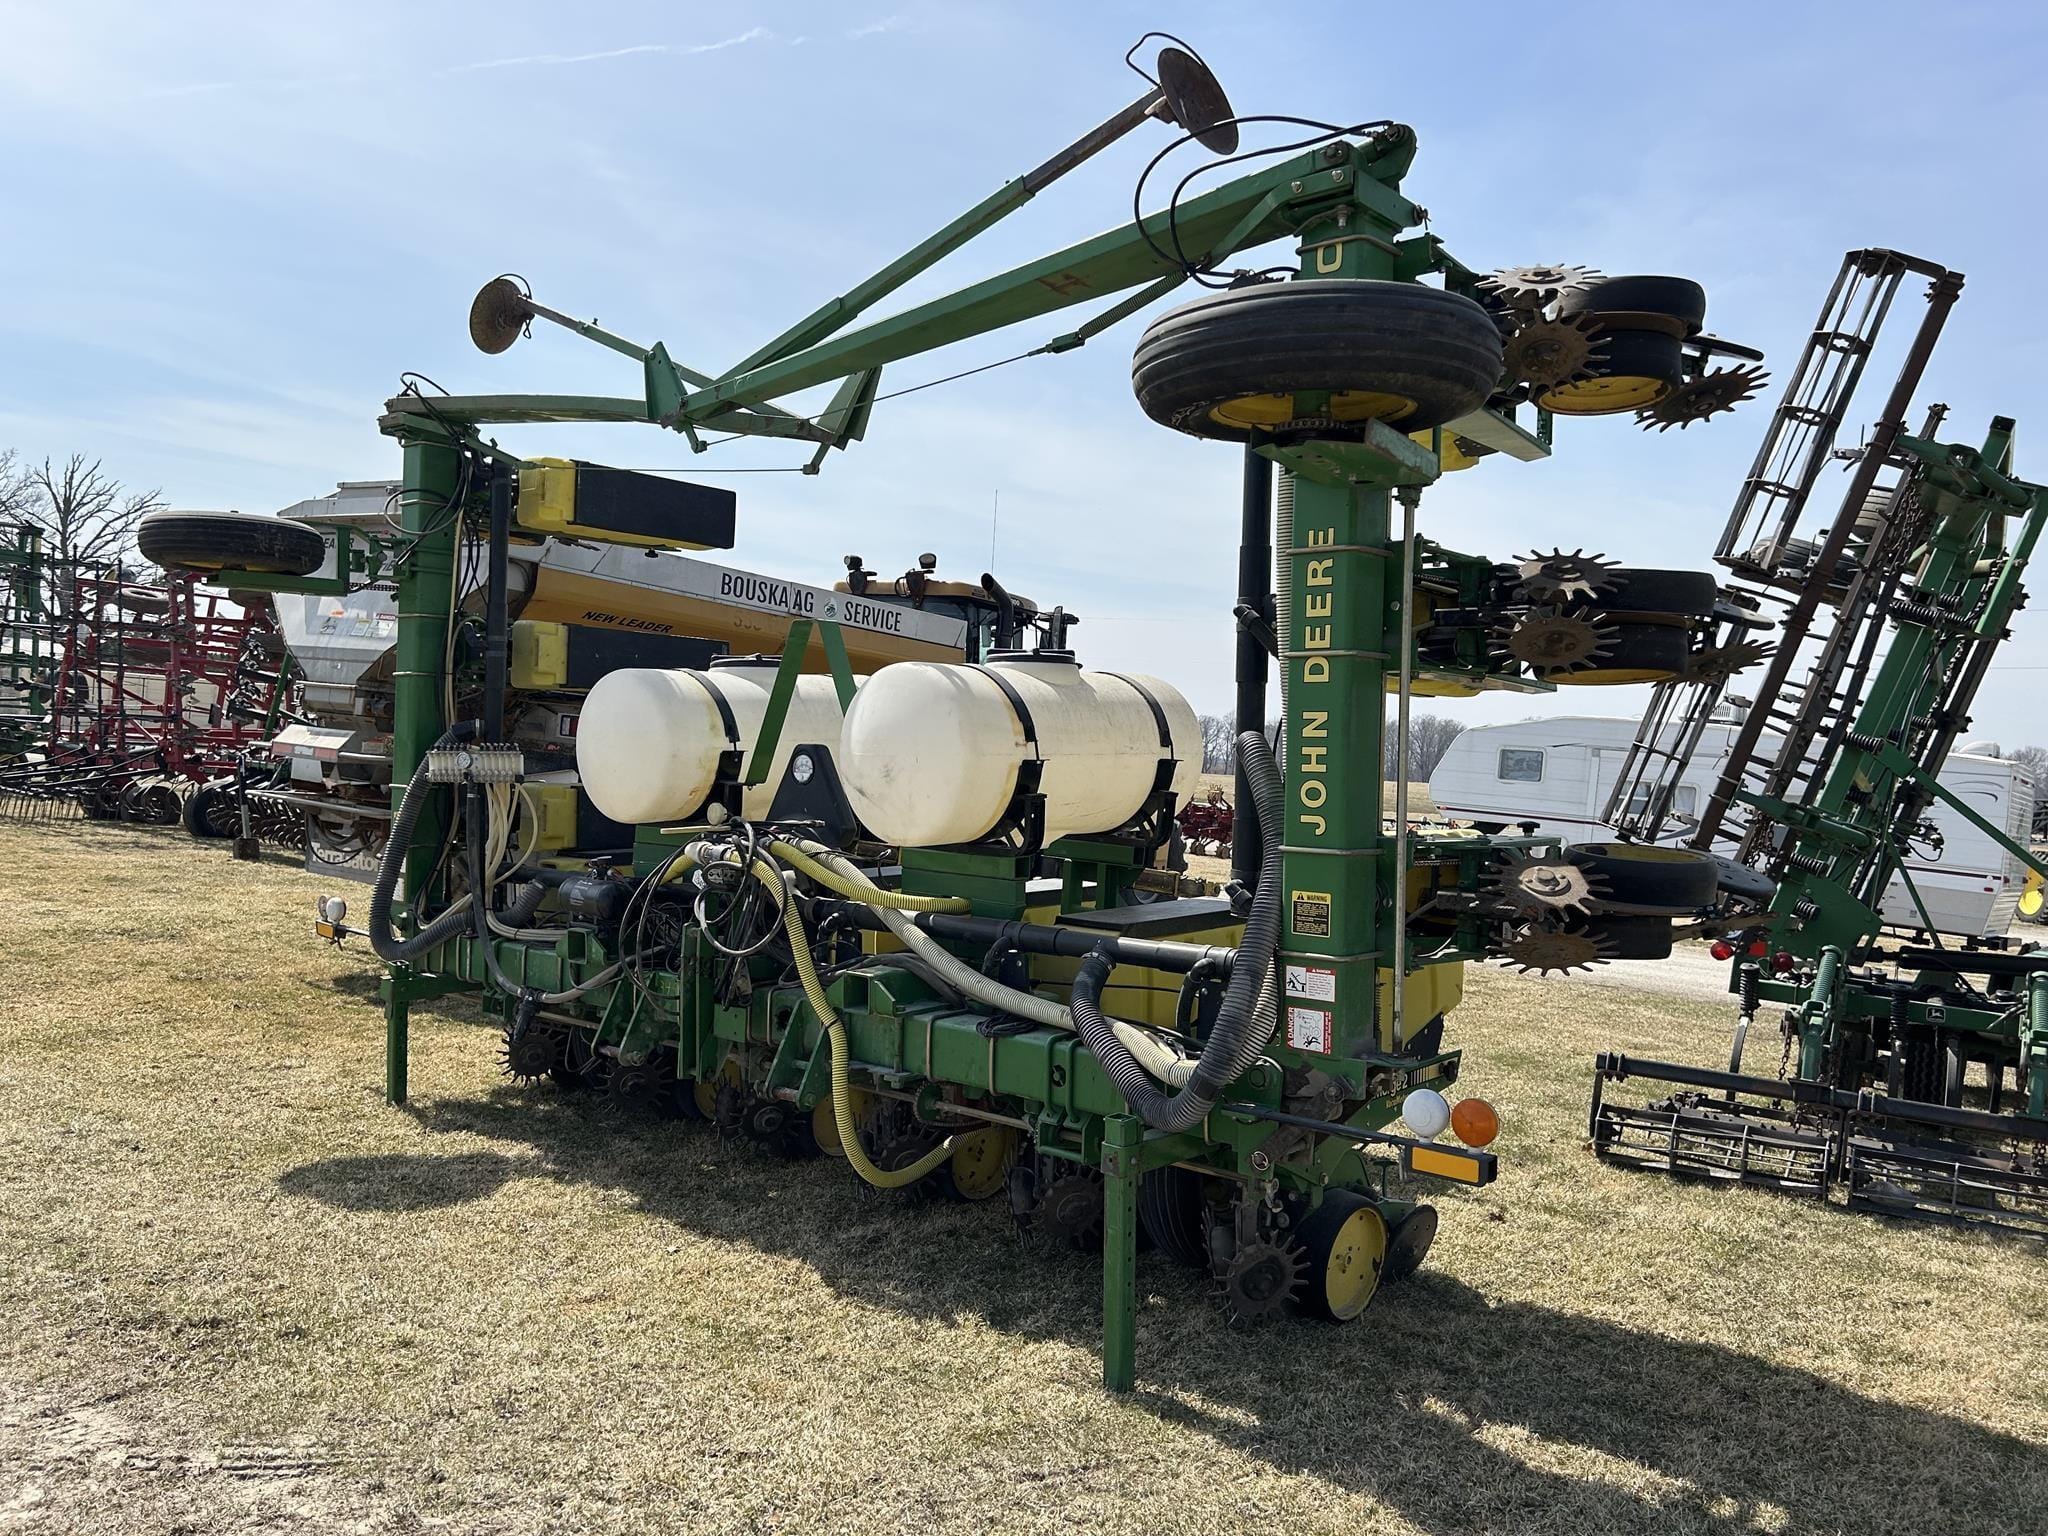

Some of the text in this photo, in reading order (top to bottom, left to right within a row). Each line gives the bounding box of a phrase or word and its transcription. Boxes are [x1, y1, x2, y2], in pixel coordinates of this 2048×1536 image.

[582, 611, 673, 633] NEW LEADER
[721, 573, 902, 632] BOUSKA AG SERVICE
[1300, 527, 1335, 836] JOHN DEERE
[1287, 1006, 1295, 1039] DANGER
